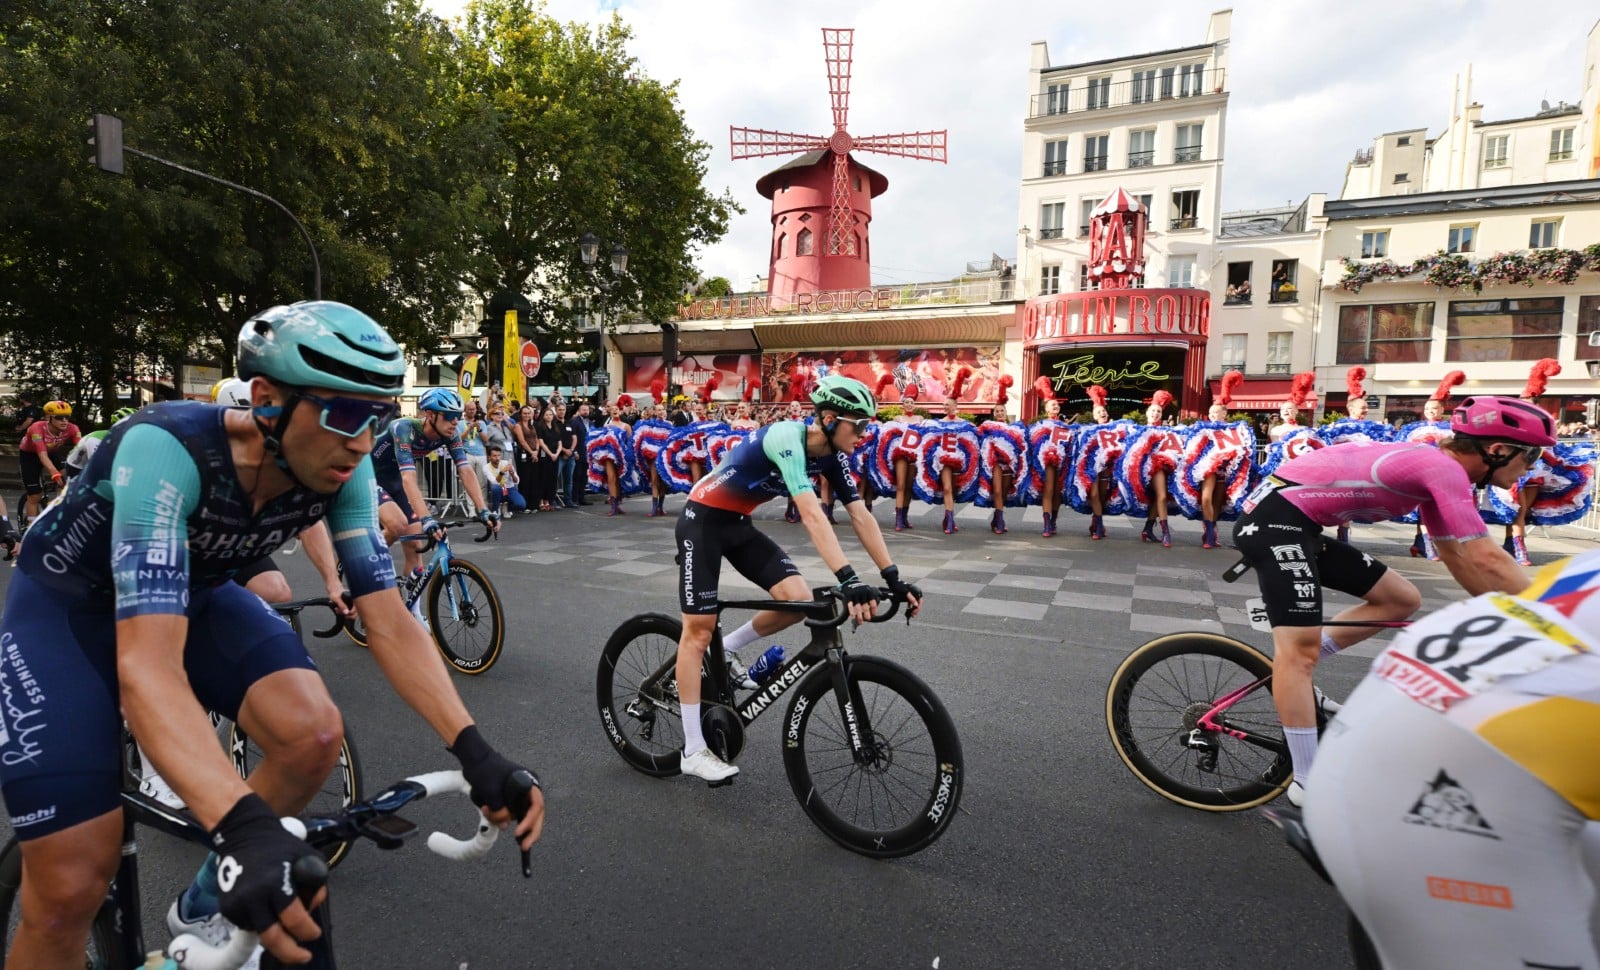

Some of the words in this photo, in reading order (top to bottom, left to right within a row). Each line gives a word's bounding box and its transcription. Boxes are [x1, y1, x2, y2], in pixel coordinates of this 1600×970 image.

[678, 296, 771, 319] MOULIN
[798, 287, 892, 314] ROUGE
[1024, 296, 1117, 340] OULIN
[1297, 490, 1376, 499] cannondale
[42, 502, 107, 574] OMNIYAT
[145, 480, 177, 566] Bianchi
[684, 551, 695, 606] DECATHLON
[1250, 606, 1268, 623] 46
[1416, 615, 1543, 683] 81
[6, 643, 46, 704] BUSINESS
[741, 691, 773, 721] VAN
[769, 661, 810, 697] RYSEL
[844, 702, 856, 725] VAN
[849, 723, 862, 752] RYSEL
[11, 804, 56, 824] anchi
